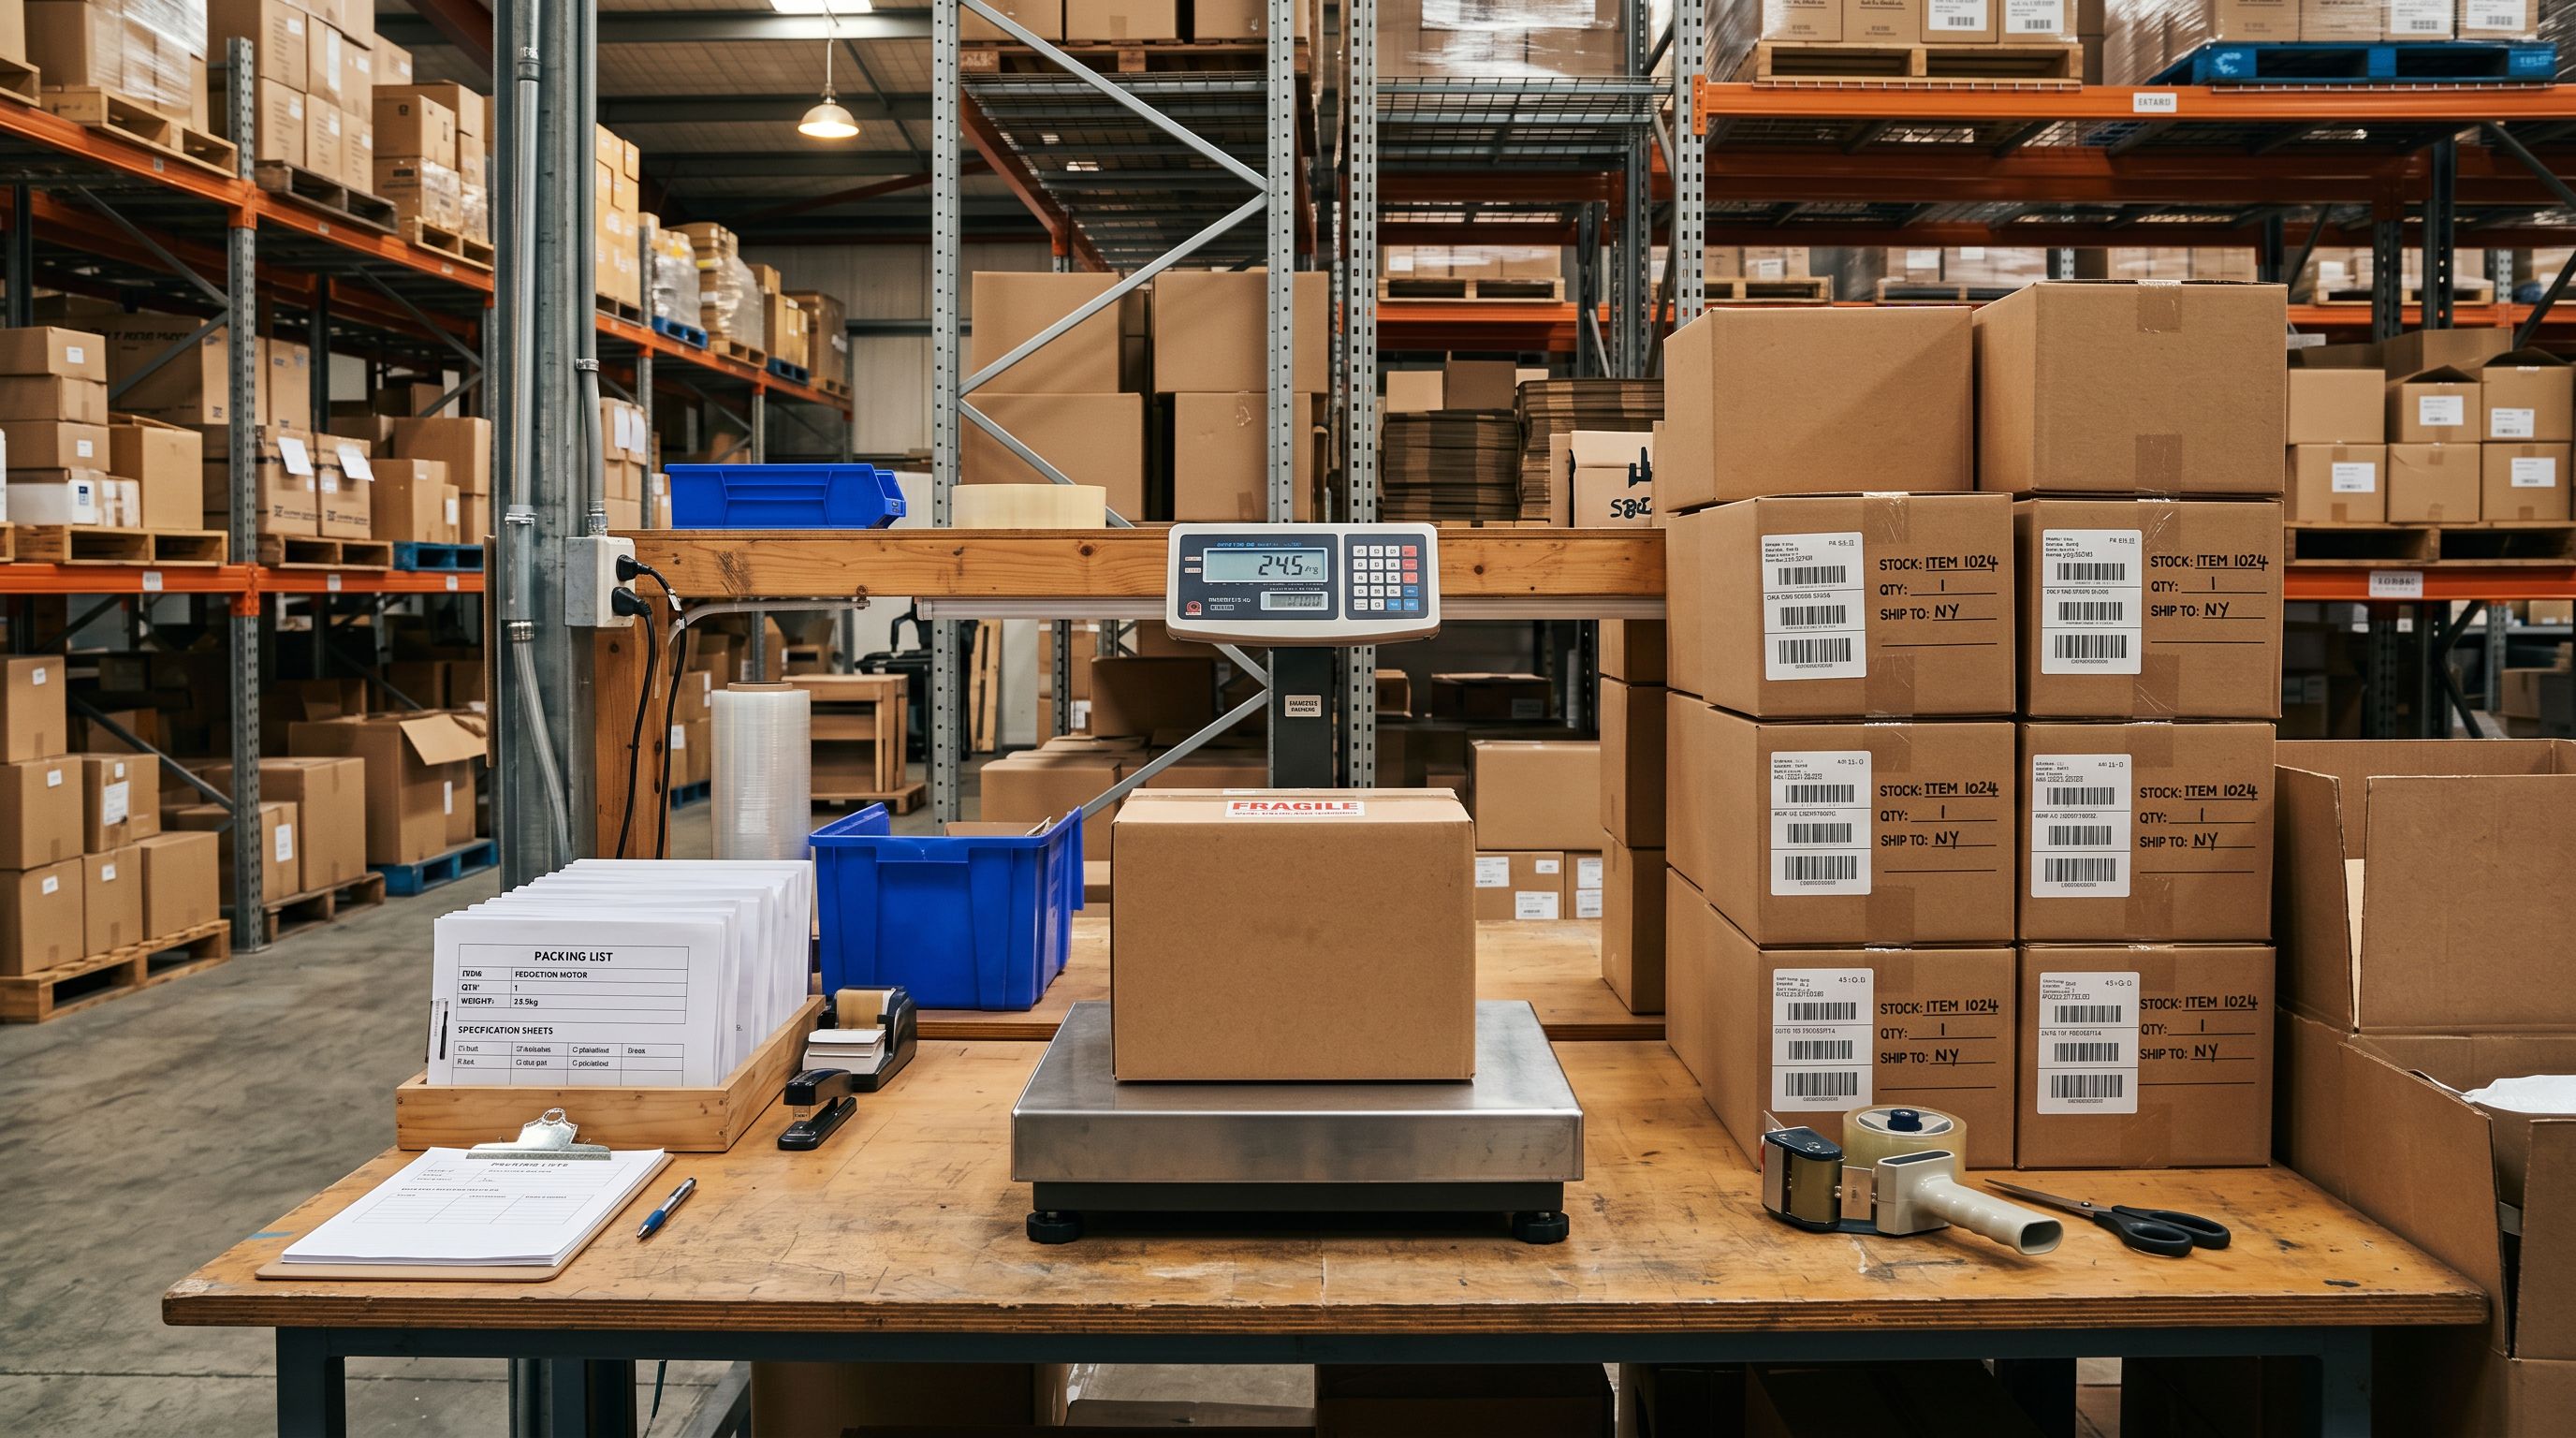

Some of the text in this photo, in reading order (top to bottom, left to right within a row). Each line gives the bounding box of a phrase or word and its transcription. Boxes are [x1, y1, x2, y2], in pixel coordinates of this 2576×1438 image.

[1258, 555, 1303, 576] 24.5
[1880, 555, 1998, 572] STOCK: ITEM 1024
[2151, 554, 2268, 571] STOCK: ITEM 1024
[1880, 584, 1907, 596] QTY:
[2151, 581, 2178, 593] QTY:
[1881, 604, 1959, 620] SHIP TO: NY
[2151, 602, 2230, 618] SHIP TO: NY
[1881, 782, 1998, 797] STOCK: ITEM 1024
[2140, 785, 2258, 800] STOCK: ITEM 1024
[1881, 811, 1908, 822] QTY:
[2140, 813, 2167, 824] QTY:
[1881, 831, 1959, 849] SHIP TO: NY
[2140, 832, 2218, 850] SHIP TO: NY
[534, 952, 613, 961] PACKING LIST
[1881, 999, 1998, 1015] STOCK: ITEM 1024
[2141, 996, 2258, 1009] STOCK: ITEM 1024
[1881, 1028, 1908, 1039] QTY:
[2141, 1024, 2167, 1035] QTY:
[1881, 1049, 1958, 1066] SHIP TO: NY
[2140, 1044, 2218, 1062] SHIP TO: NY
